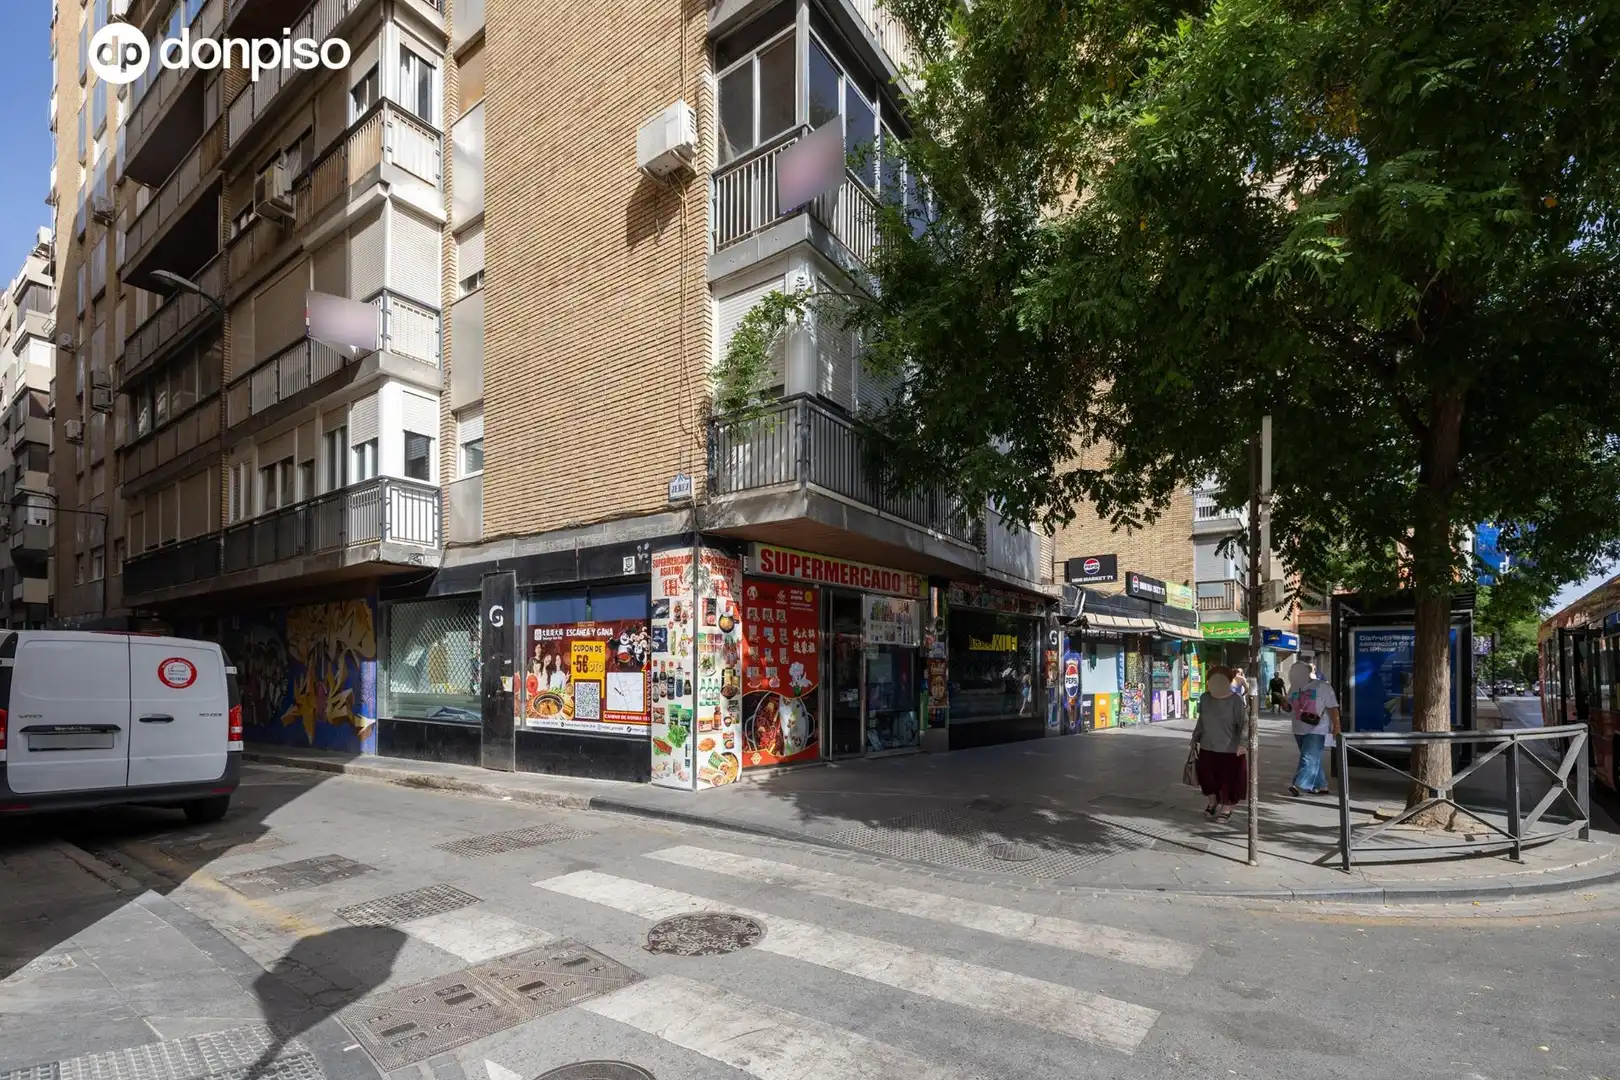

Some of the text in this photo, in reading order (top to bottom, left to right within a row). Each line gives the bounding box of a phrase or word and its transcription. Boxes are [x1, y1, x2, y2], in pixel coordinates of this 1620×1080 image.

[652, 554, 693, 569] SUPERMERCADO
[760, 548, 901, 593] SUPERMERCADO
[566, 627, 614, 637] ESCANEA Y GANA
[595, 645, 603, 653] DE
[1065, 677, 1077, 685] PEPSI
